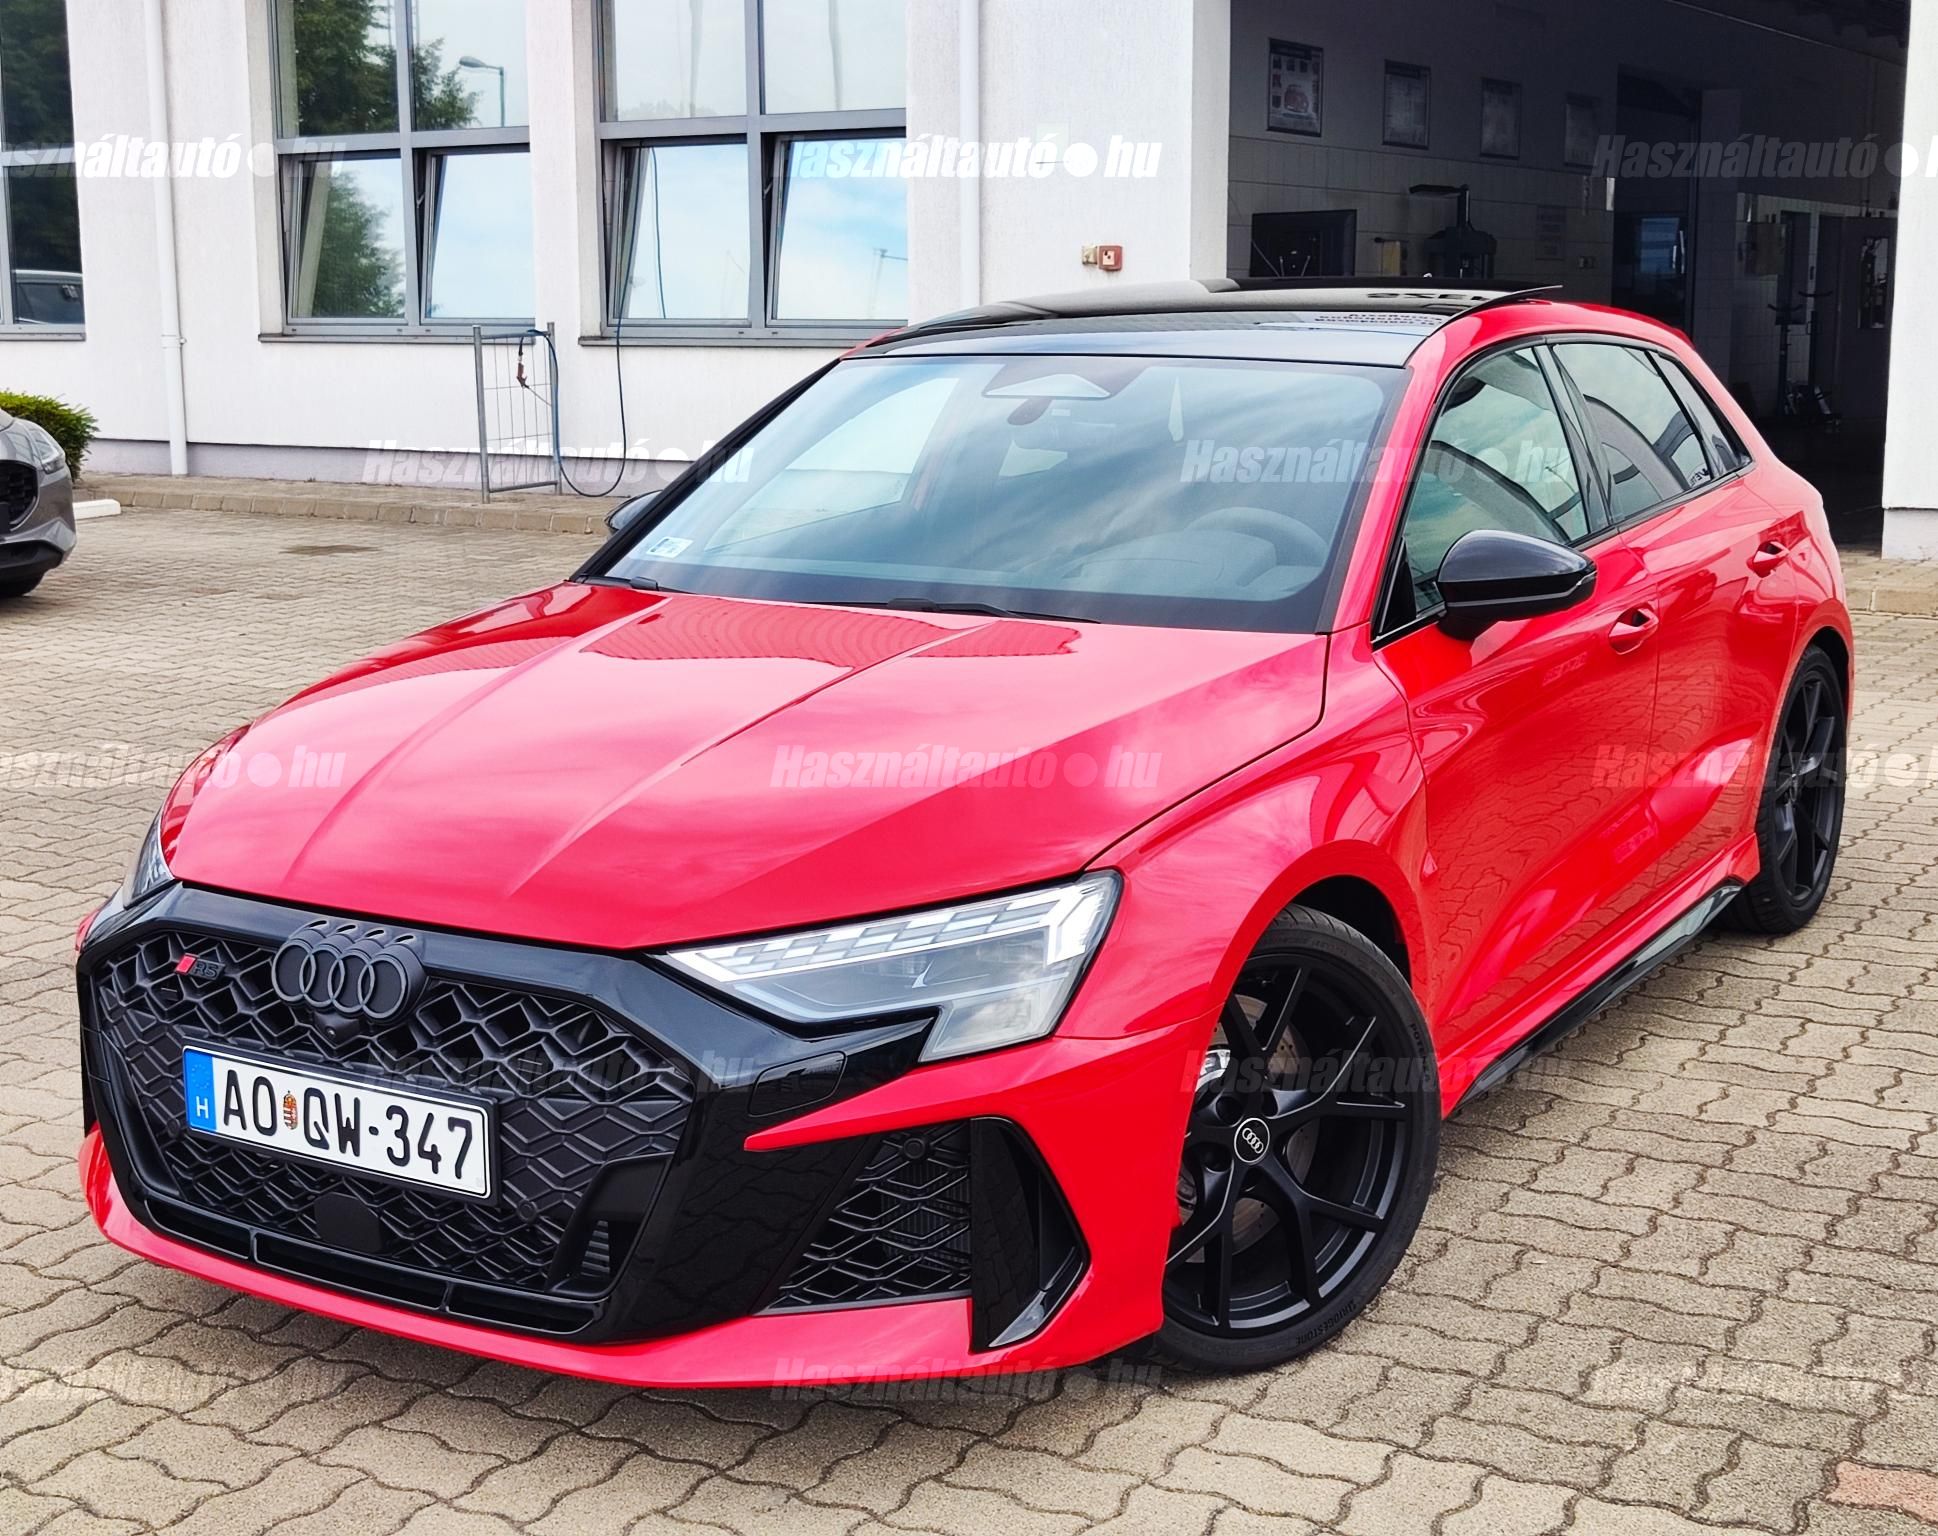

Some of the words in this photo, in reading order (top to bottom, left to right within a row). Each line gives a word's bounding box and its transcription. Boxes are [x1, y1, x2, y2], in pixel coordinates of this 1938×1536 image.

[193, 960, 219, 979] RS
[196, 1096, 209, 1120] H
[223, 1069, 278, 1137] AO
[303, 1087, 473, 1180] QW-347
